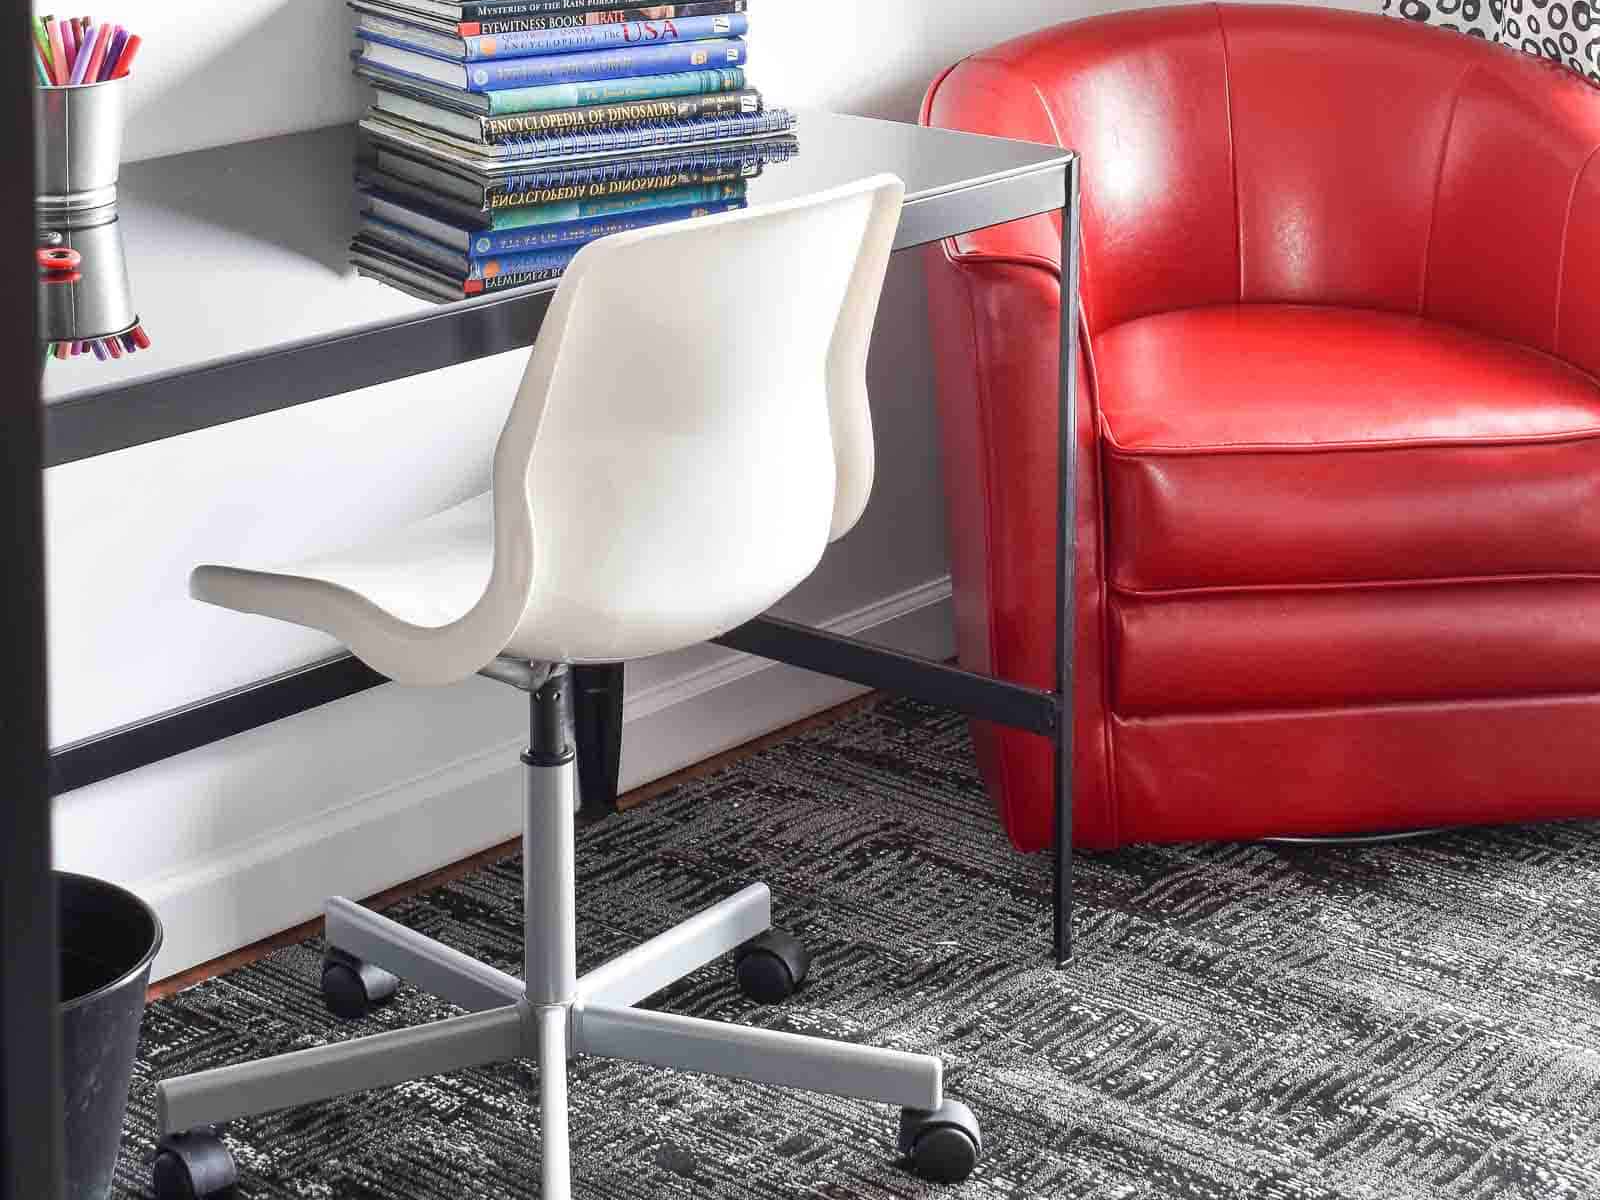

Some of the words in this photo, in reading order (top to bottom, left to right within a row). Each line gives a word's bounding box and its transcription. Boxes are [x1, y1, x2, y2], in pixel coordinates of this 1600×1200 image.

[478, 4, 527, 17] MYSTERIES
[529, 3, 541, 11] OF
[543, 1, 561, 10] THE
[563, 0, 585, 8] RAIN
[481, 19, 546, 34] EYEWITNESS
[549, 15, 585, 29] BOOKS
[621, 20, 679, 42] USA
[490, 111, 585, 134] ENCYCLOPEDIA
[589, 109, 605, 123] OF
[608, 103, 677, 122] DINOSAURS
